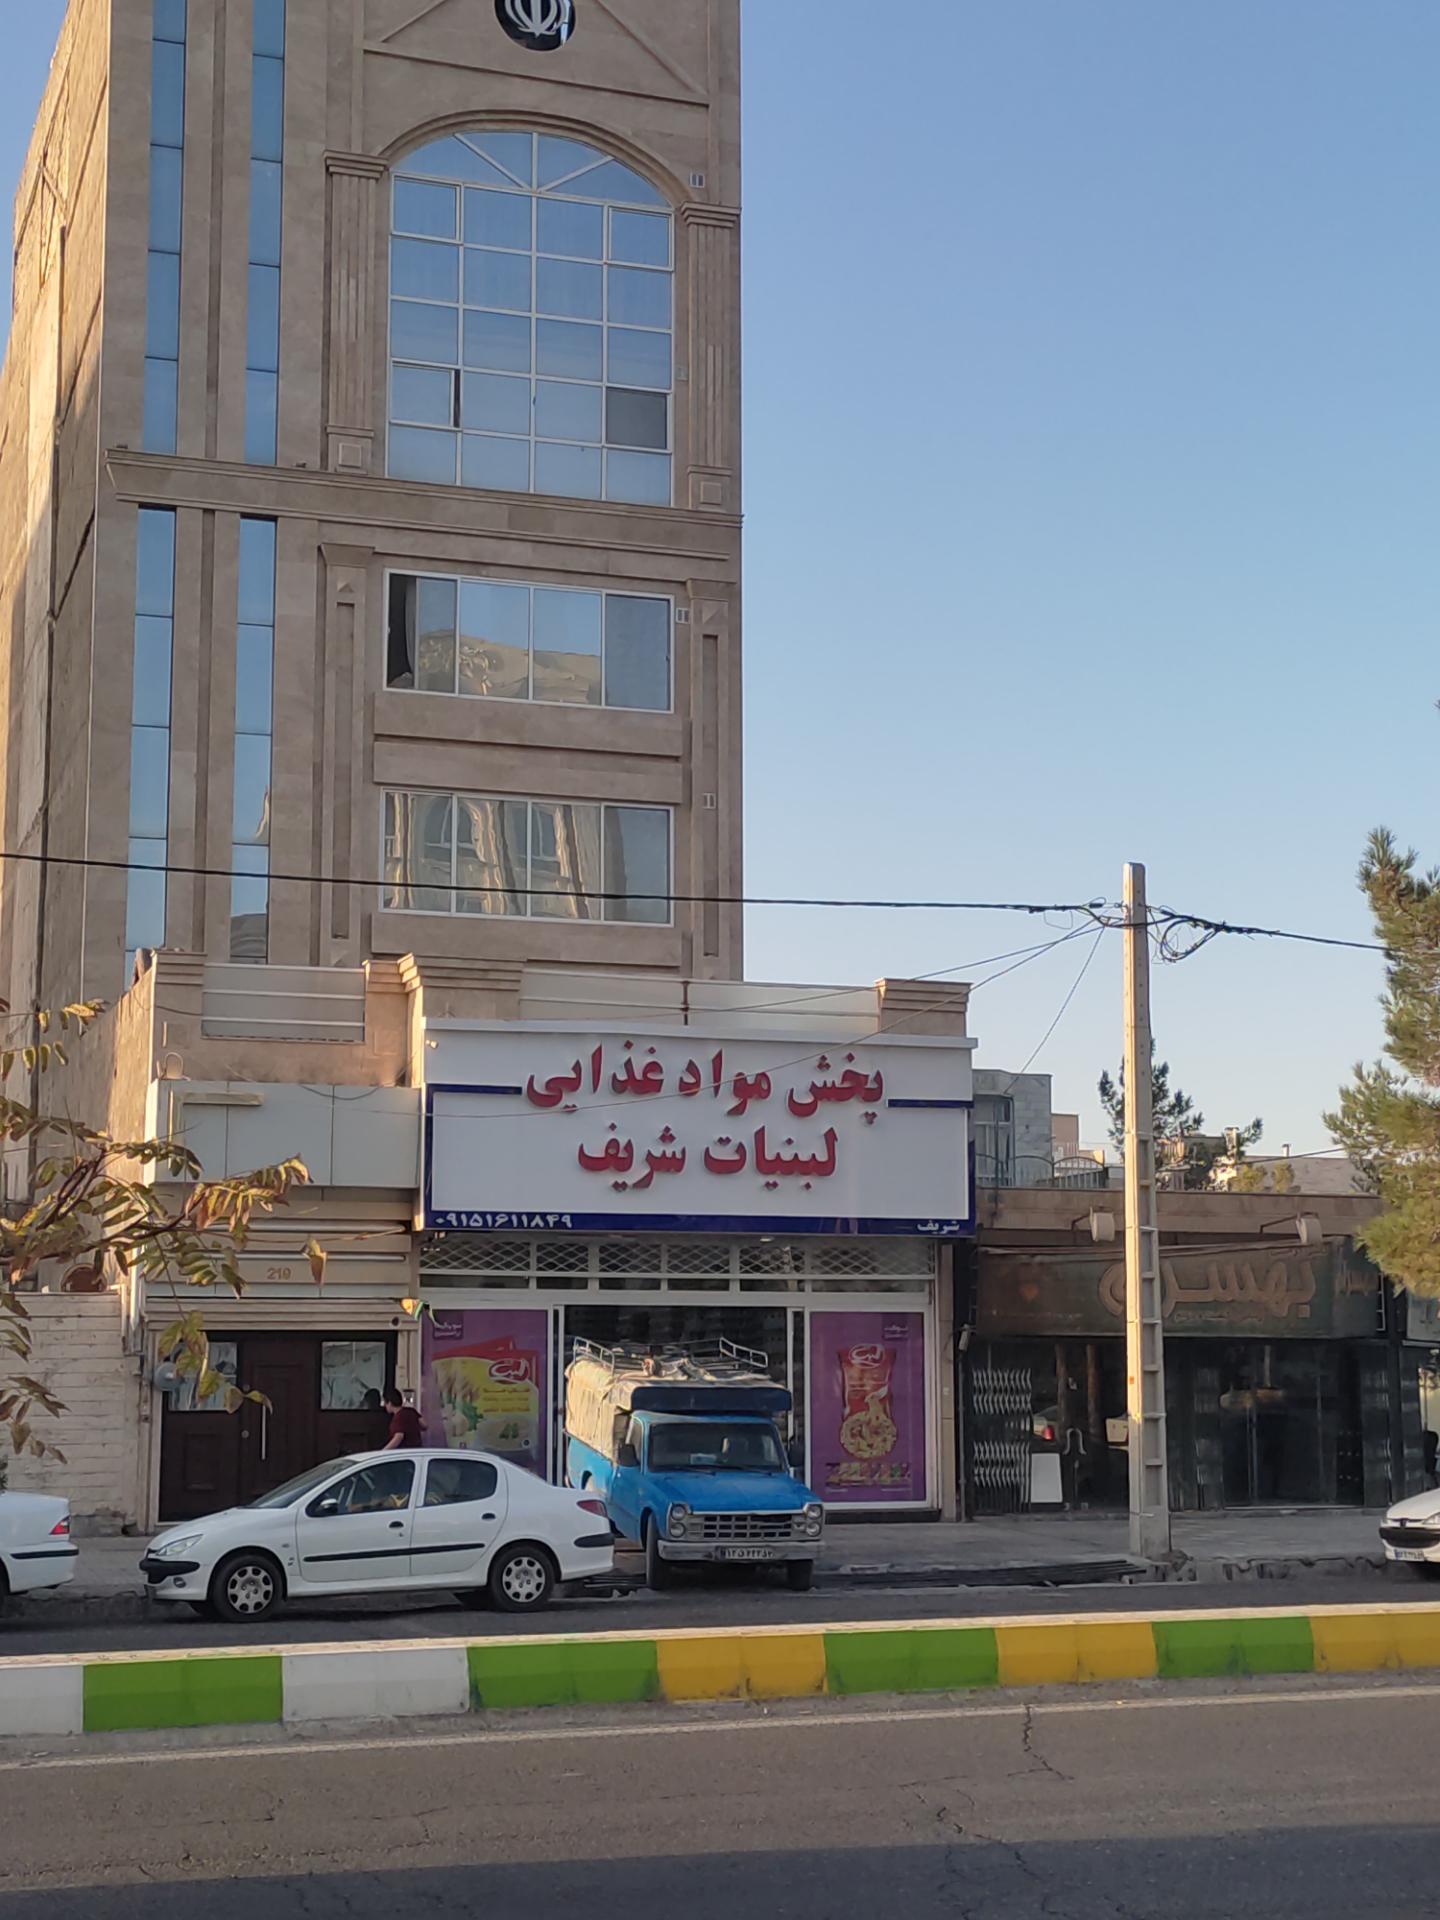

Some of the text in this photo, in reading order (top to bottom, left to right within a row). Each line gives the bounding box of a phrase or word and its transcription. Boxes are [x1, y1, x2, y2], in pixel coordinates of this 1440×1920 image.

[527, 1039, 883, 1125] پخش مواد غذایی
[577, 1122, 838, 1192] لبنیات شریف
[435, 1213, 572, 1229] ۰۹۱۵۱۶۱۱۸۴۹
[917, 1219, 960, 1234] شریف
